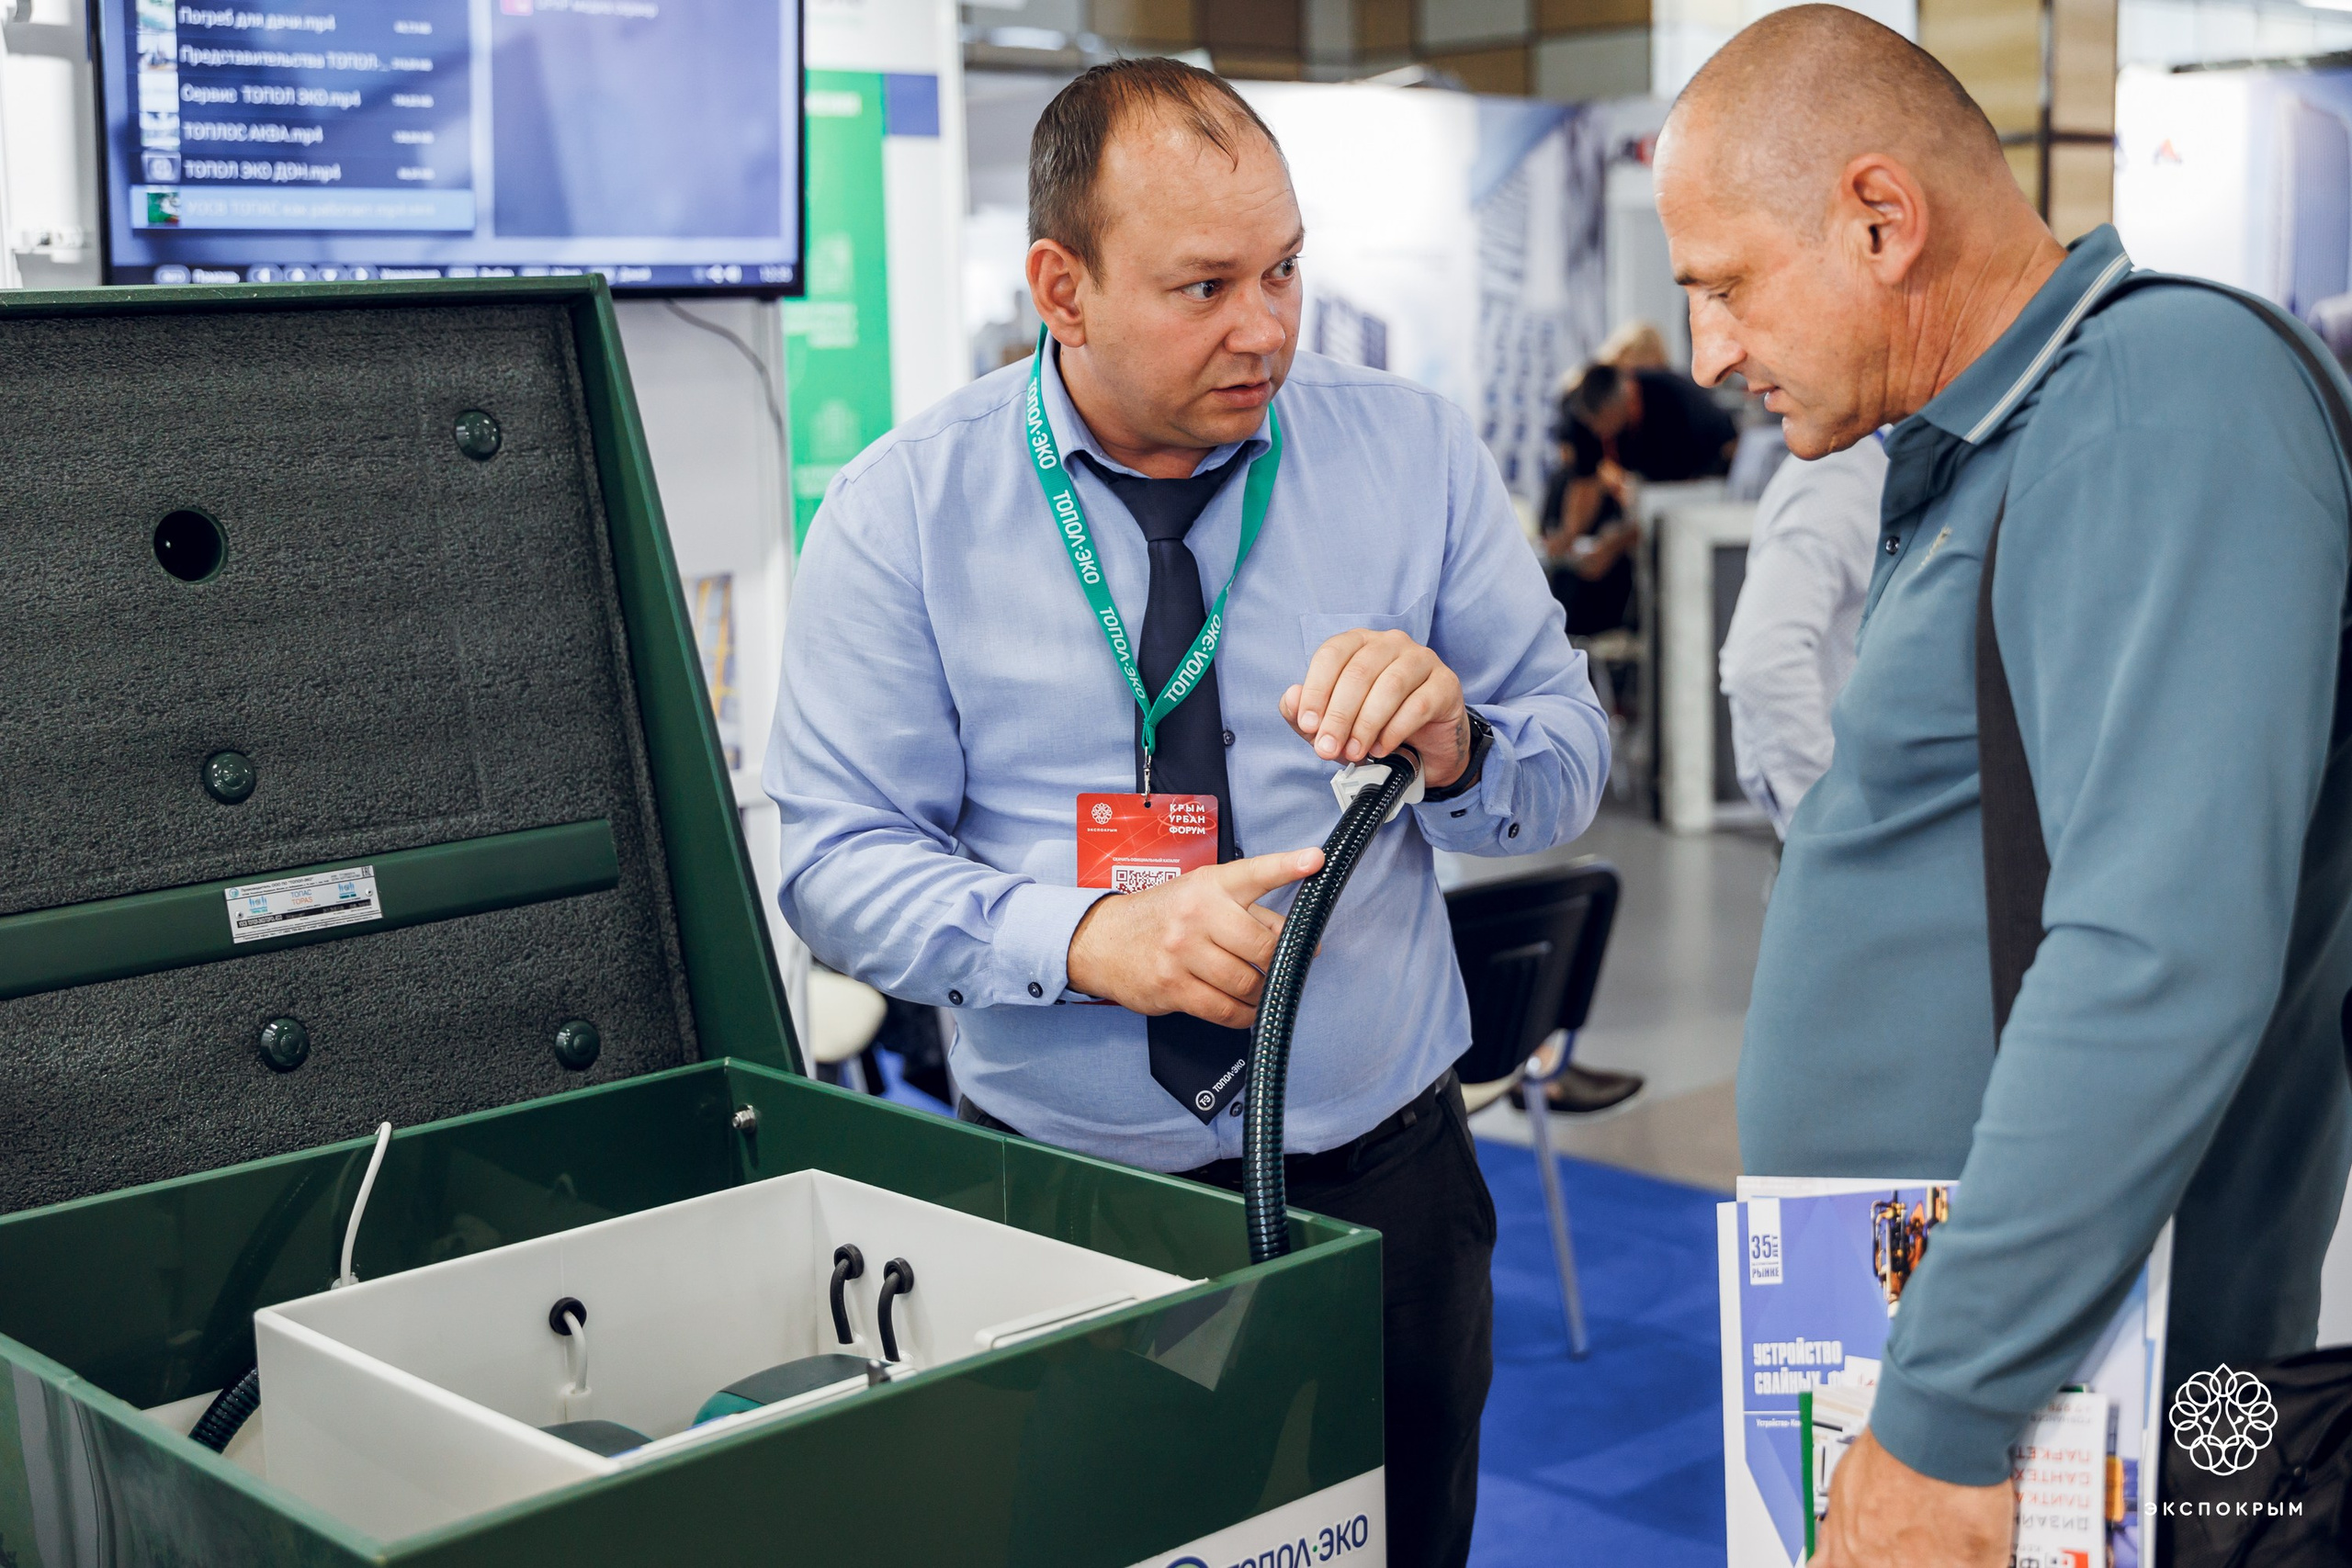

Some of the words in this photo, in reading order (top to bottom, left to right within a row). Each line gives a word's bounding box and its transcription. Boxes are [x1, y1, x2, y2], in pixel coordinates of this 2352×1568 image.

[241, 85, 295, 106] ТОПОЛ
[184, 160, 239, 180] ТОПОЛ
[240, 161, 272, 180] ЭКО
[1169, 804, 1205, 813] КРЫМ
[1169, 815, 1205, 824] УРБАН
[1169, 826, 1206, 835] ФОРУМ
[290, 889, 312, 898] ТОПАС
[291, 897, 313, 906] TOPAS
[1751, 1235, 1771, 1259] 35
[1752, 1267, 1780, 1278] РЫНКЕ
[1753, 1337, 1843, 1366] УСТРОЙСТВО
